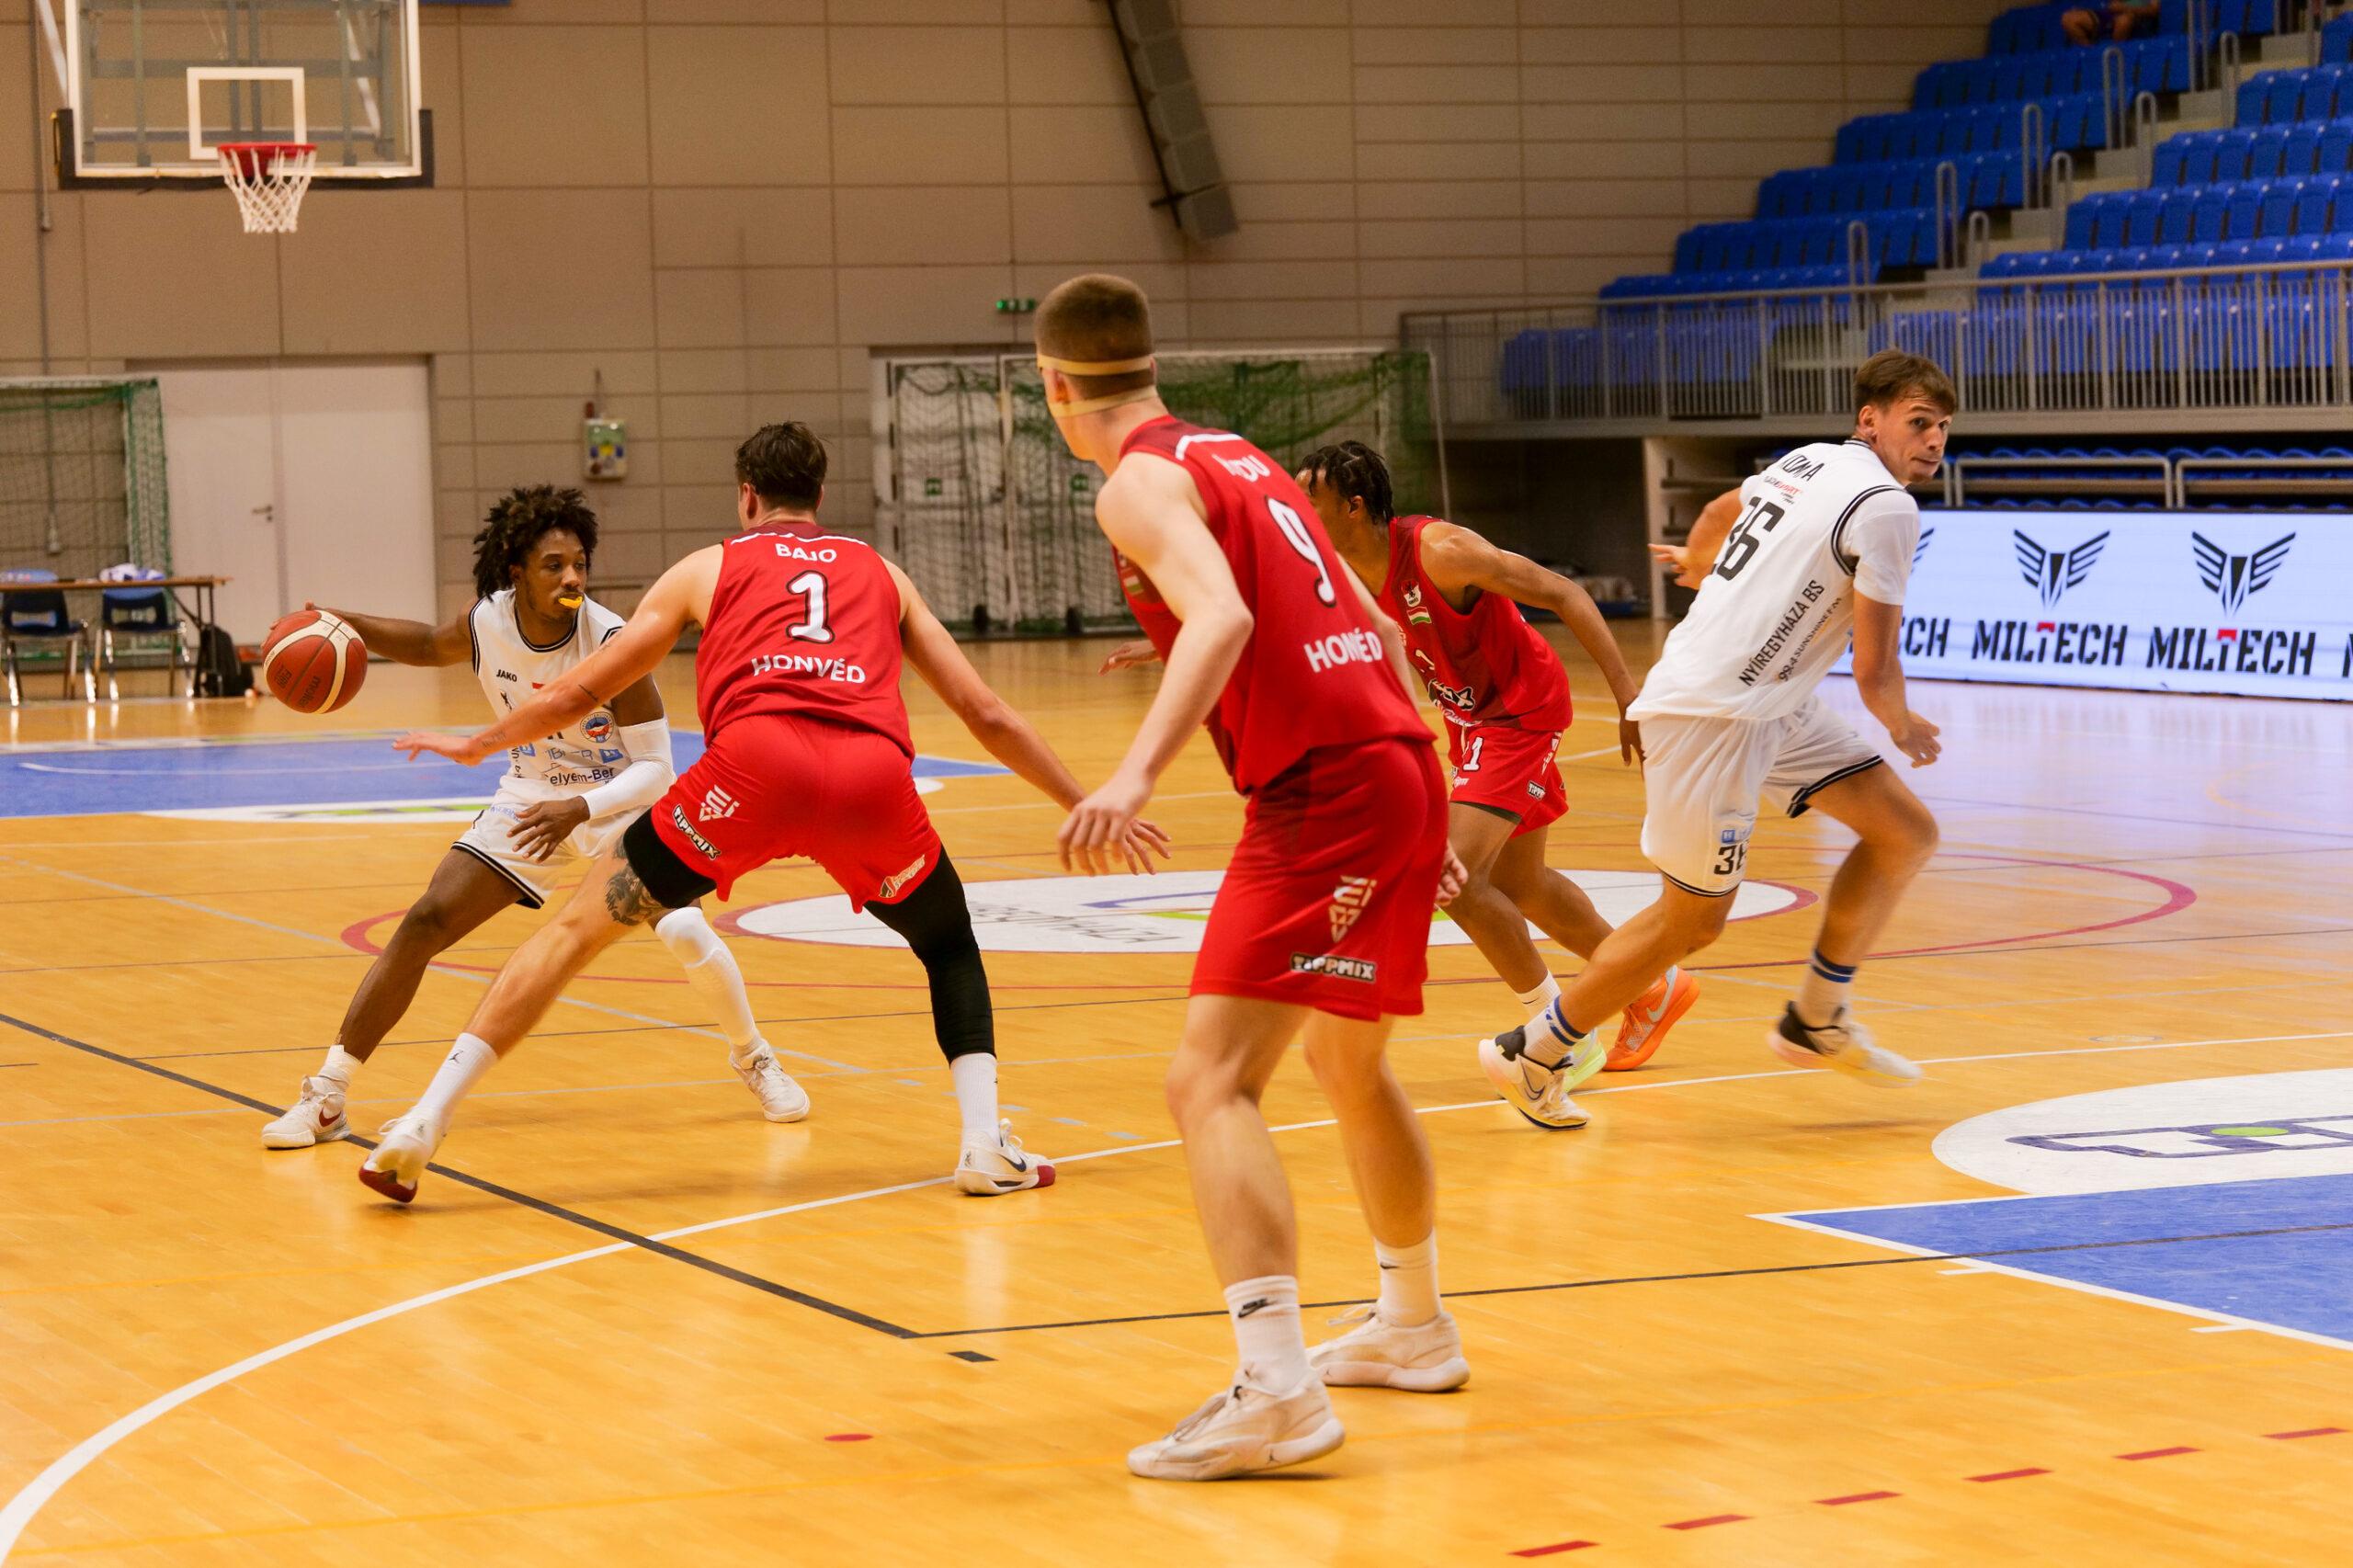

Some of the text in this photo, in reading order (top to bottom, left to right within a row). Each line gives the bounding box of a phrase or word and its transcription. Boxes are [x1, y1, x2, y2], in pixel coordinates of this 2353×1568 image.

[775, 543, 837, 563] BAJO
[1266, 495, 1336, 608] 9
[785, 570, 835, 643] 1
[1738, 580, 1824, 687] NYÍREGYHÁZA BS
[1971, 619, 2128, 667] MILTECH
[2145, 625, 2316, 677] MILTECH
[496, 669, 517, 682] JAKO
[750, 653, 866, 684] HONVÉD
[673, 805, 721, 858] TIPPMIX
